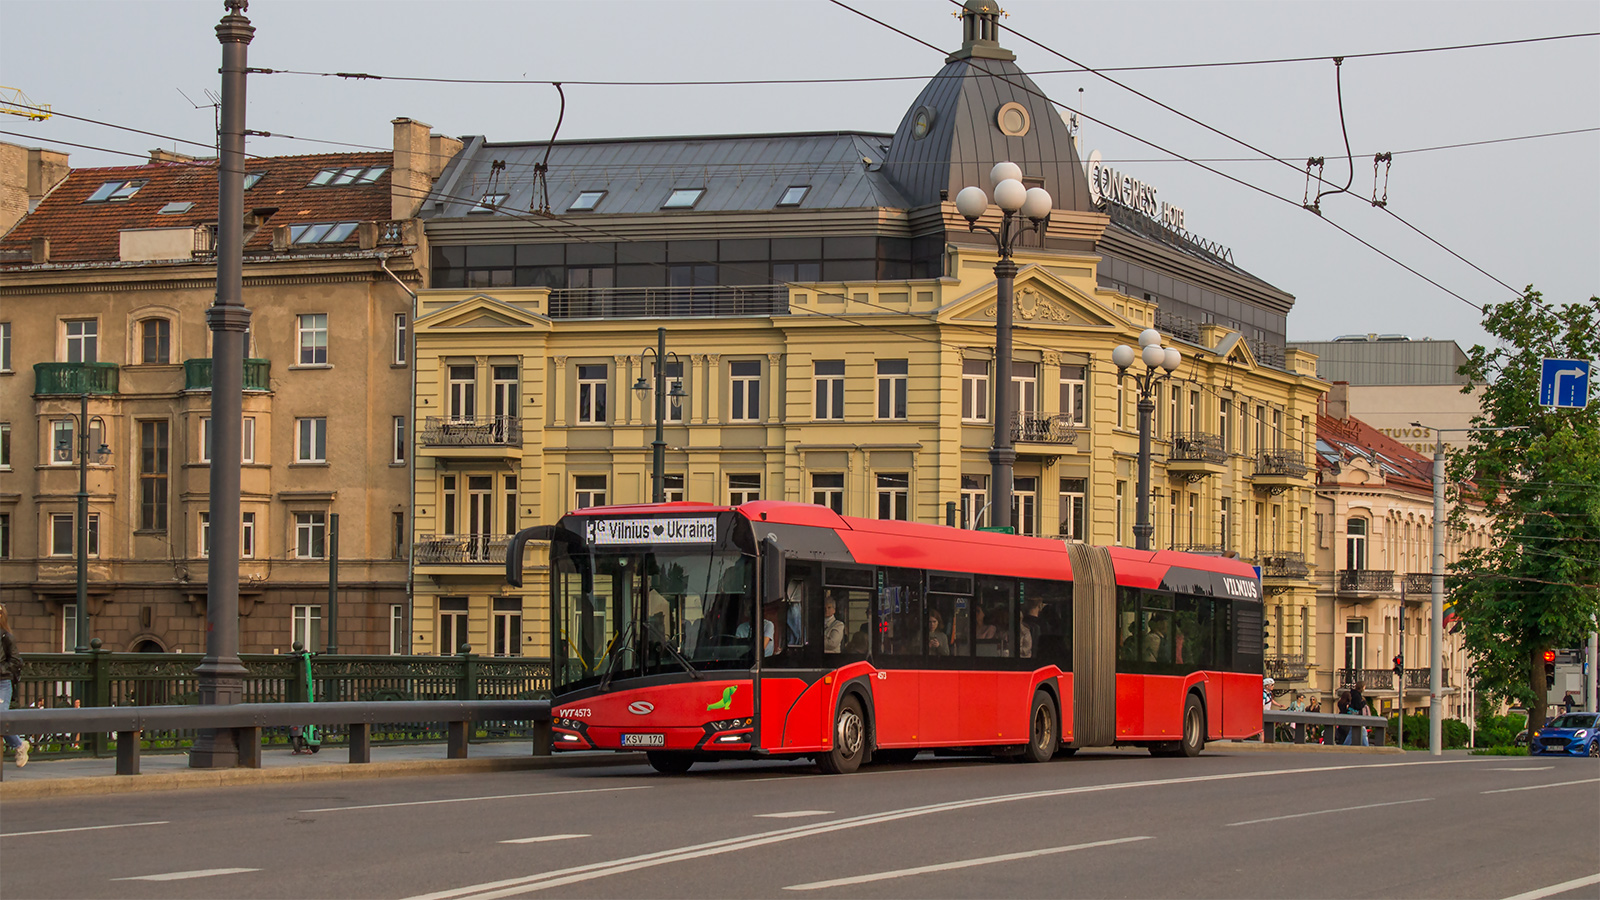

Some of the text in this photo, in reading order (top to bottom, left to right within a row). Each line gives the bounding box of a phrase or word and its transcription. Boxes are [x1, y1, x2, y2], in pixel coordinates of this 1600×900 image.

[1091, 159, 1186, 229] CONGRESS HOTEL
[1378, 428, 1431, 438] TUVOS
[609, 522, 650, 539] Vilnius
[1223, 577, 1258, 599] VILNIUS
[625, 735, 663, 744] KSV 170
